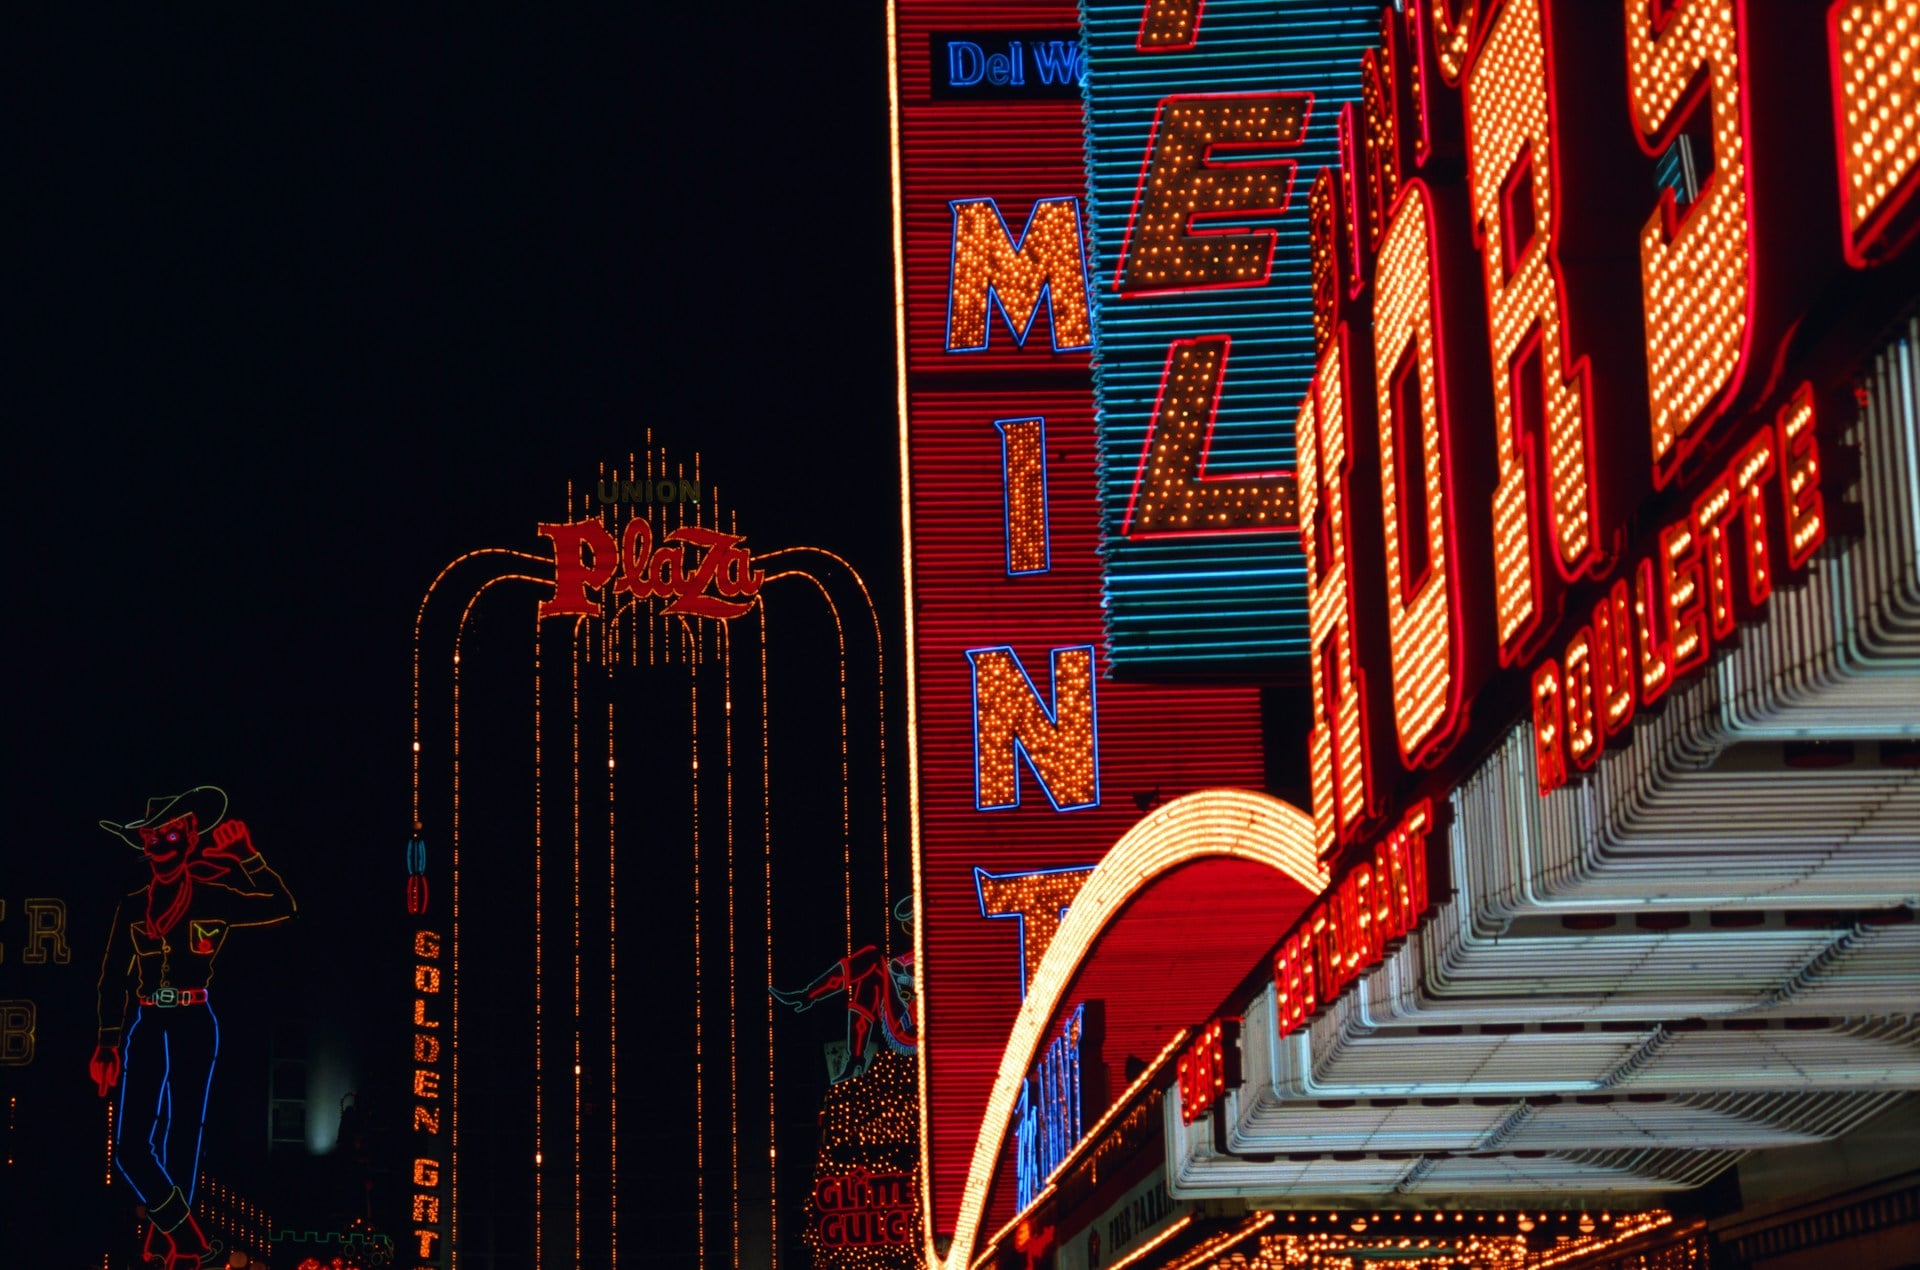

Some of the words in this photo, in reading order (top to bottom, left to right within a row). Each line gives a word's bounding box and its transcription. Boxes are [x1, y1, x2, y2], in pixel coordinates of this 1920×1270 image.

[947, 41, 1025, 86] Del
[597, 480, 701, 504] UNION
[1530, 381, 1827, 797] ROULETTE
[1273, 797, 1432, 1040] RESTAURANT
[413, 929, 441, 1135] GOLDEN
[411, 1157, 441, 1270] GAT
[816, 1165, 918, 1212] GLITTE
[1132, 1179, 1183, 1236] PARKI
[820, 1208, 914, 1248] GULC
